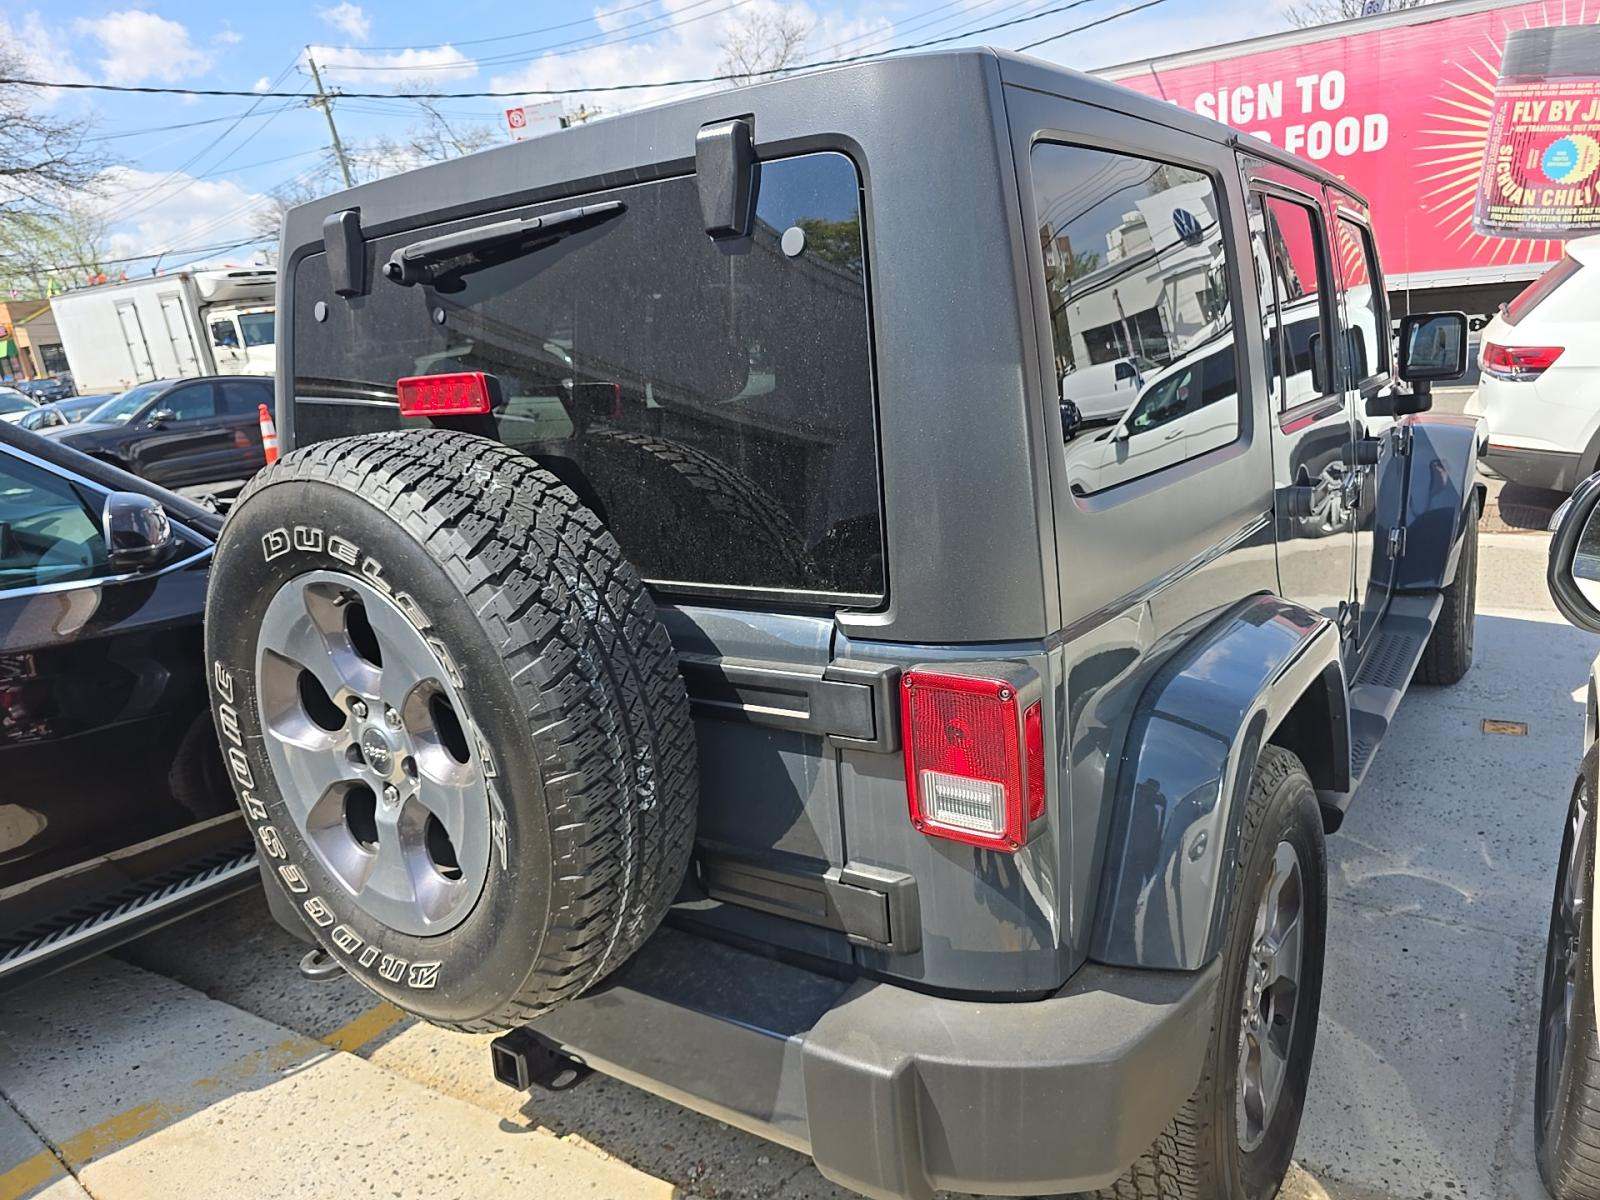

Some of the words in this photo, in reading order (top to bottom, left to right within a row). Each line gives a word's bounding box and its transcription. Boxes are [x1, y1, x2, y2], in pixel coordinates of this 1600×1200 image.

[1195, 80, 1283, 125] SIGN
[1296, 70, 1345, 114] TO
[1512, 99, 1545, 122] FLY
[1549, 98, 1580, 122] BY
[1285, 113, 1389, 160] FOOD
[1497, 144, 1536, 206] SICHUAN
[1542, 185, 1592, 206] CHILI
[261, 525, 465, 690] DUELER
[215, 660, 442, 990] BRIDGESTONE
